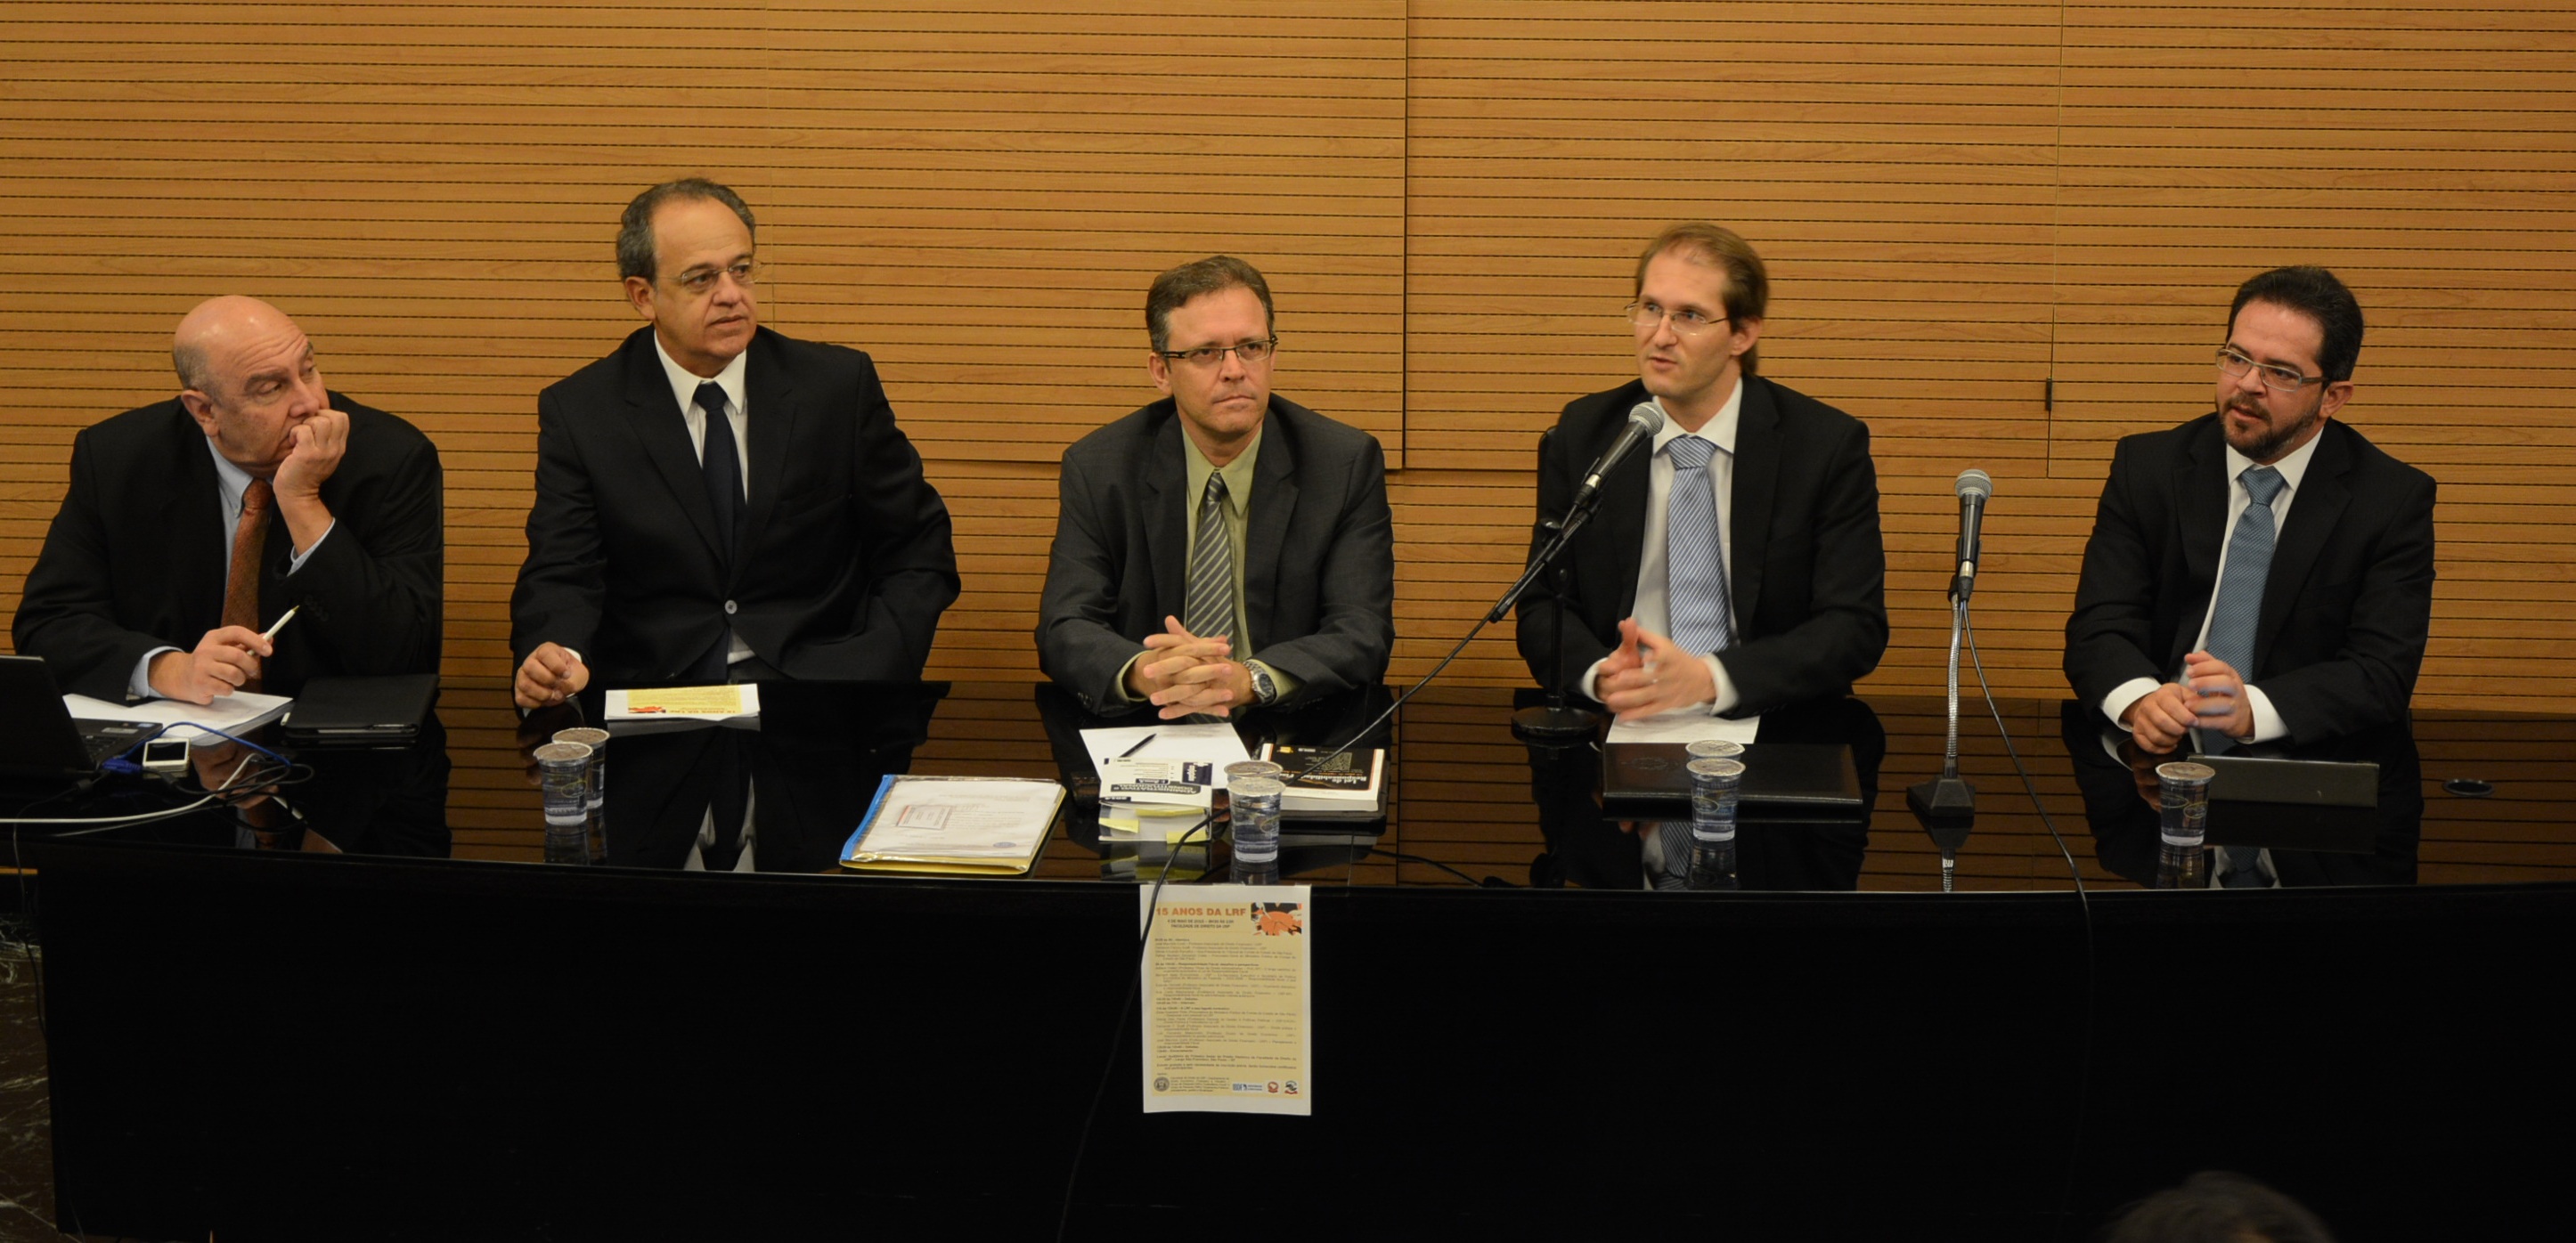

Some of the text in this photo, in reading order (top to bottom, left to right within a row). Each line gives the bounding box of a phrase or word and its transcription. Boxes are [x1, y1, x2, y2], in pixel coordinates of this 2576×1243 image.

[1156, 907, 1247, 916] 15 ANOS DA LRF
